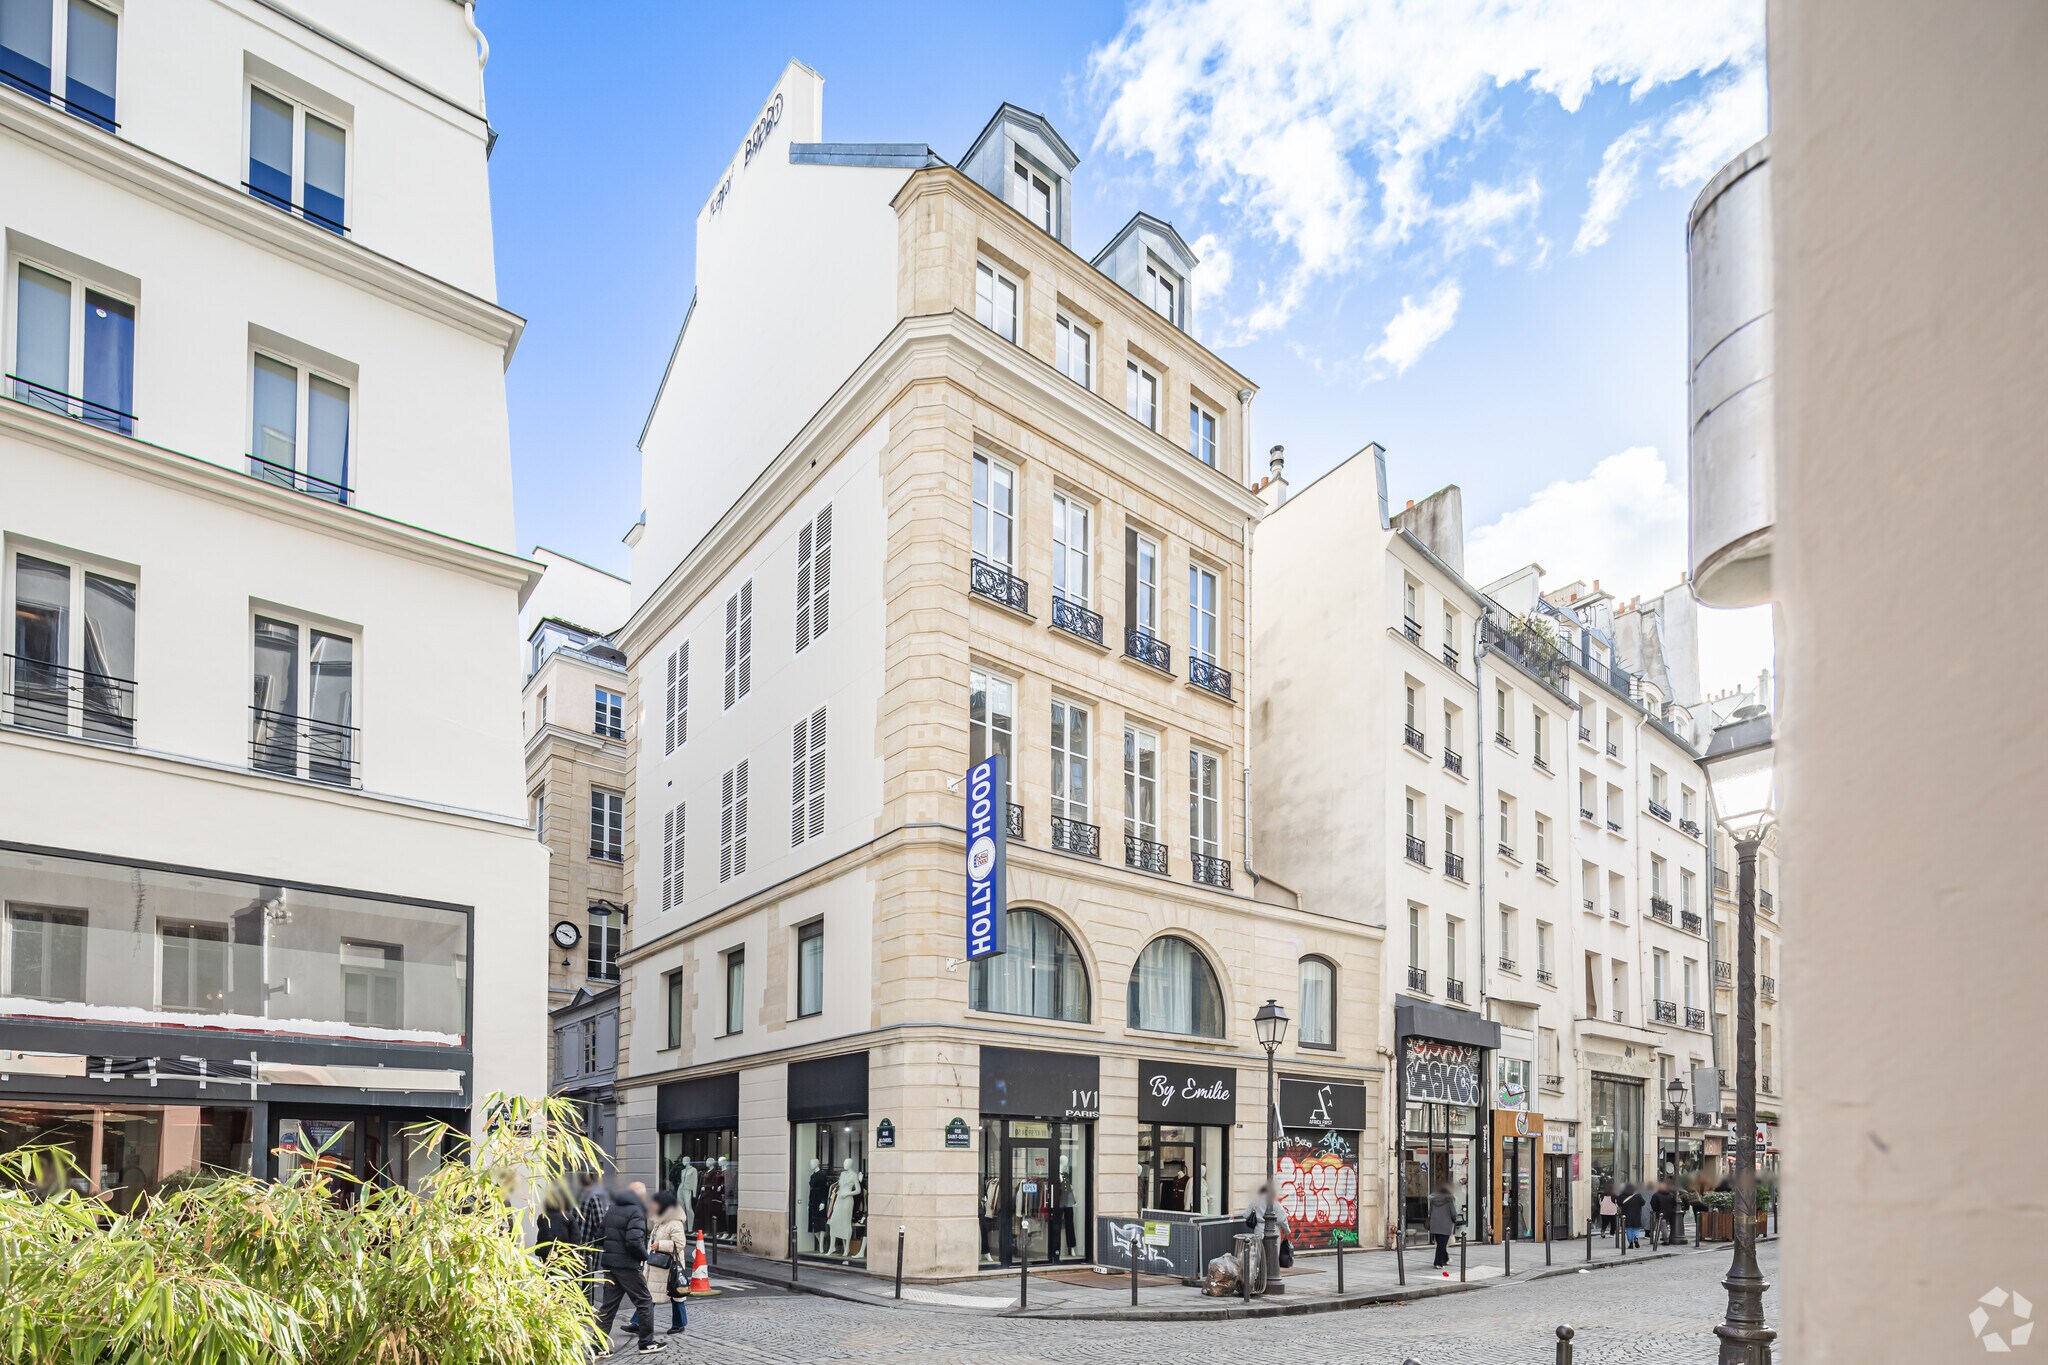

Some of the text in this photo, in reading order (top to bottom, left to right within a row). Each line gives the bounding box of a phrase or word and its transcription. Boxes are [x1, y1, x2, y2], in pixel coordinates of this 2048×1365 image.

[971, 763, 991, 956] HOLLY HOOD
[1149, 1075, 1230, 1107] By Emilie
